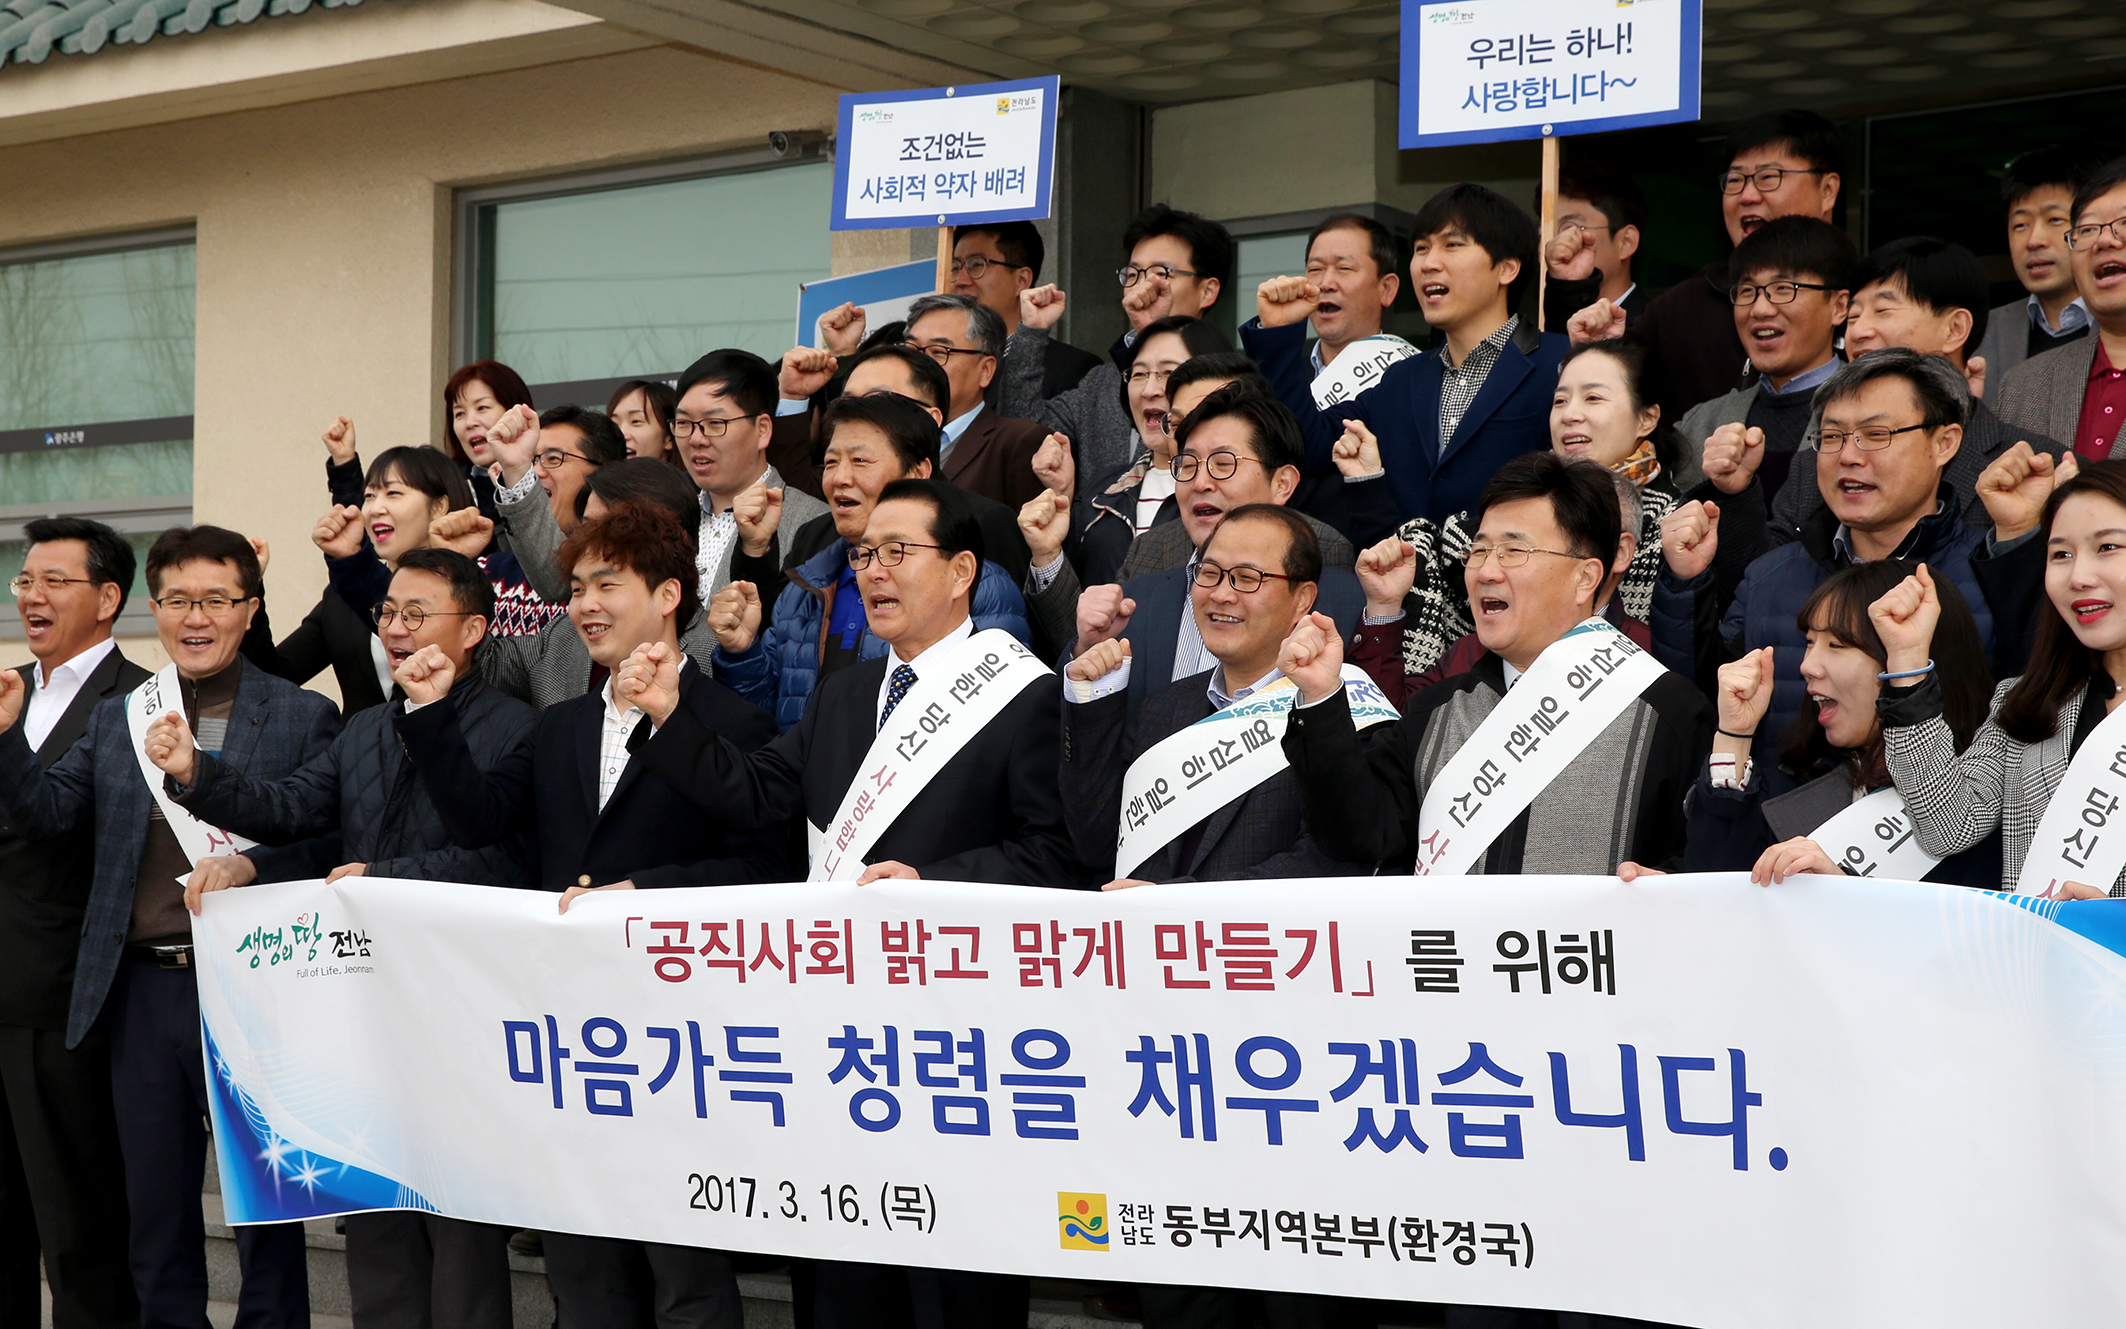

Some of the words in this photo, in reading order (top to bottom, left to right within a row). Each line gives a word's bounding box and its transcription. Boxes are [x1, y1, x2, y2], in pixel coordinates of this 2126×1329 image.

[1467, 33, 1556, 69] 우리는
[1566, 21, 1633, 58] 하나!
[1462, 70, 1638, 113] 사랑합니다~
[899, 131, 987, 162] 조건없는
[860, 174, 927, 204] 사회적
[934, 170, 978, 199] 약자
[984, 165, 1026, 196] 배려
[949, 653, 1010, 705] 일한
[1566, 634, 1642, 702] 열심히
[896, 702, 951, 762] 당신
[1182, 719, 1275, 790] 열심히
[1503, 696, 1570, 763] 일한
[1126, 777, 1176, 832] 일한
[1448, 759, 1507, 829] 당신
[2061, 787, 2119, 869] 당신
[296, 969, 308, 978] Full
[310, 967, 318, 977] of
[320, 966, 342, 976] Life,
[329, 929, 372, 958] 전남
[881, 919, 988, 985] 밝고
[1013, 920, 1126, 989] 맑게
[1405, 930, 1464, 993] 를
[1492, 929, 1616, 995] 위해
[502, 1014, 793, 1128] 마음가득
[827, 1024, 1087, 1141] 청렴을
[1126, 1032, 1789, 1172] 채우겠습니다.
[688, 1173, 769, 1219] 2017.
[778, 1180, 807, 1222] 3.
[820, 1184, 868, 1227] 16.
[881, 1181, 937, 1234] (목)
[1118, 1203, 1155, 1225] 전라
[1120, 1225, 1156, 1246] 남도
[1162, 1204, 1534, 1269] 동부지역본부(환경국)
